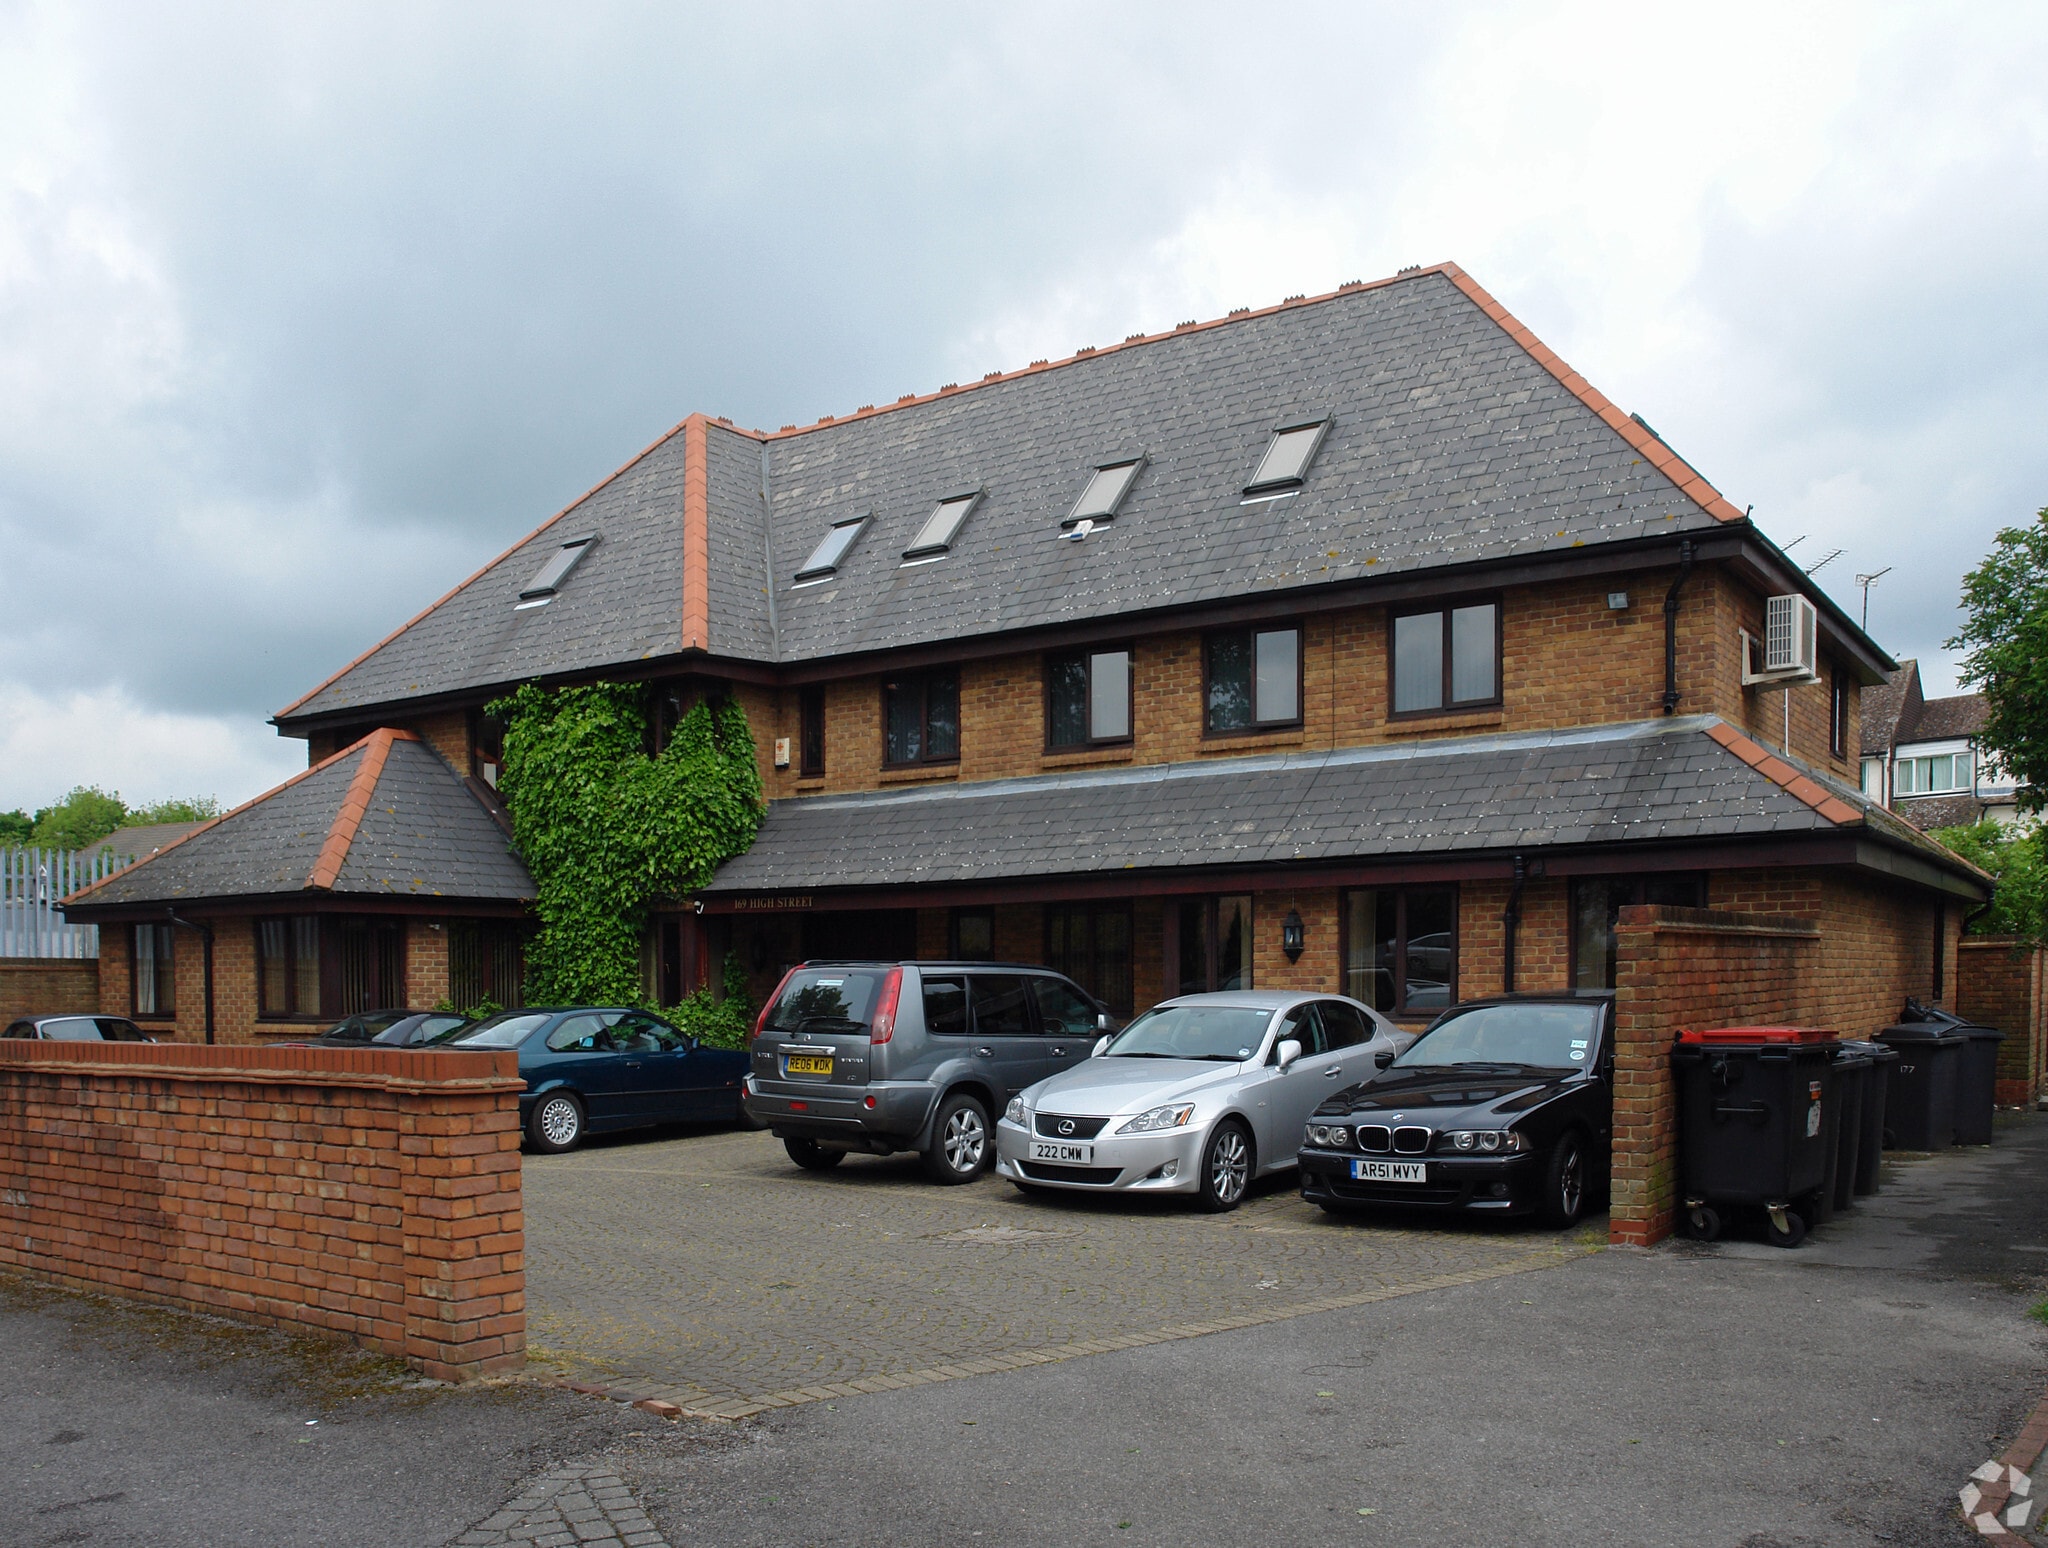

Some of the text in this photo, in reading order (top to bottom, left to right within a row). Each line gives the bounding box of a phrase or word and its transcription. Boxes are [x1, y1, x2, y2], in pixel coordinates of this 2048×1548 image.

[734, 896, 814, 909] 169 HIGH STREET
[789, 1057, 831, 1071] RE06 WDK
[1037, 1144, 1082, 1161] 222 CMW
[1361, 1163, 1420, 1179] AR51 MVY
